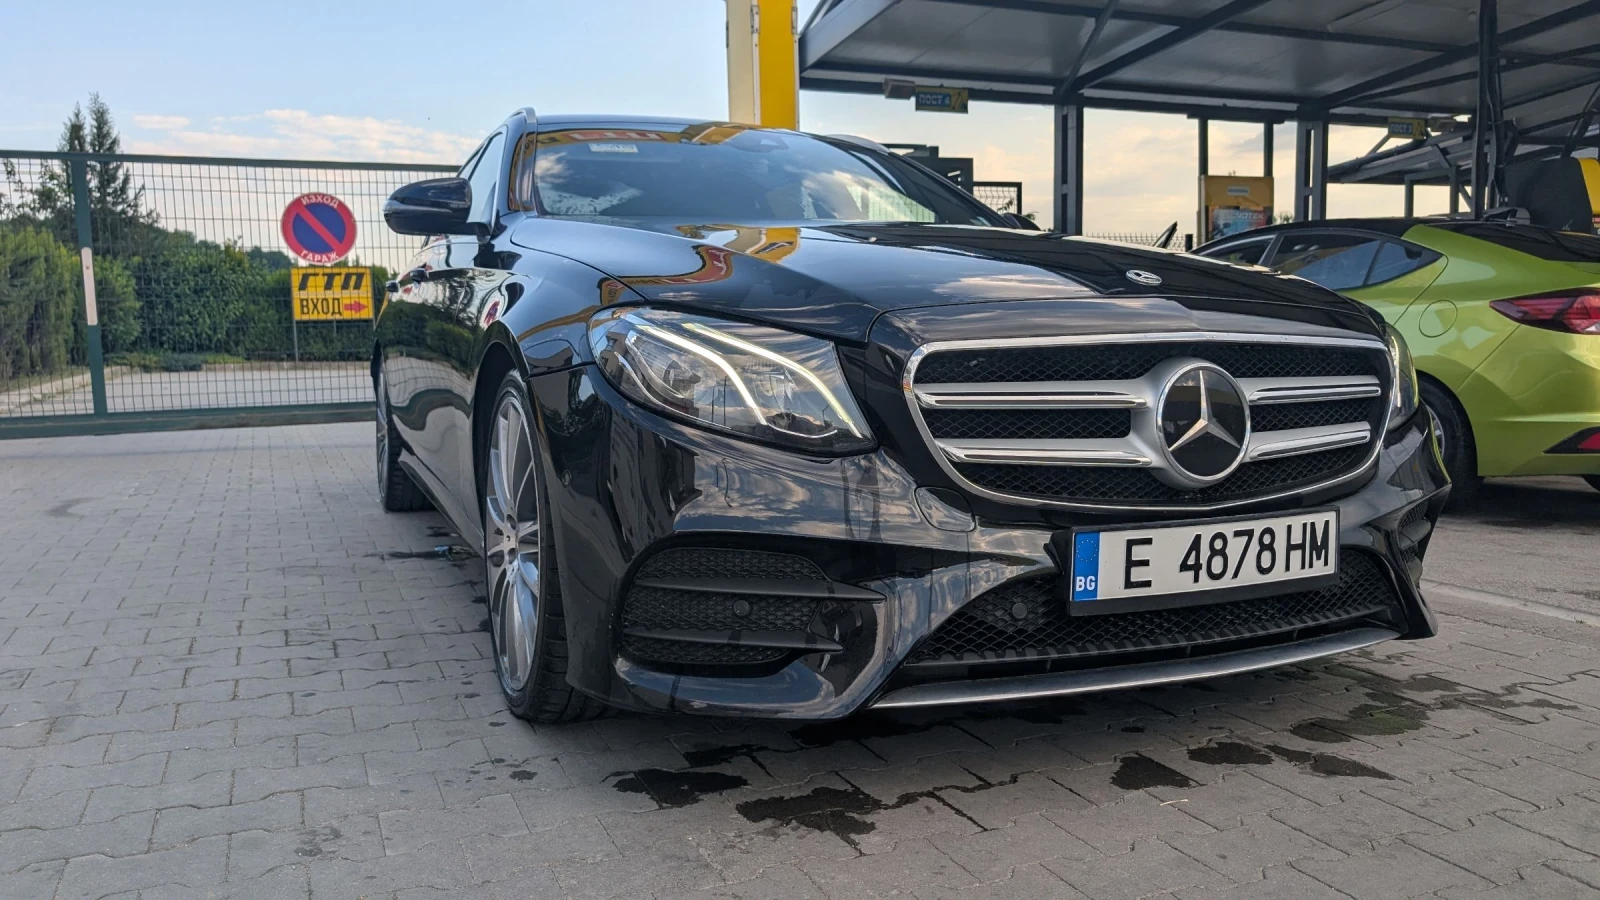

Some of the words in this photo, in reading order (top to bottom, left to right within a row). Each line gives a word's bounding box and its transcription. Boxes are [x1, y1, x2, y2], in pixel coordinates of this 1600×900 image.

[919, 94, 943, 104] ПОСТ
[301, 194, 339, 208] ИЗХОД
[301, 250, 339, 263] ГАРАЖ
[298, 273, 365, 291] ГТП
[300, 298, 342, 316] ВХОД
[1179, 525, 1277, 584] 4878
[1075, 575, 1096, 592] BG
